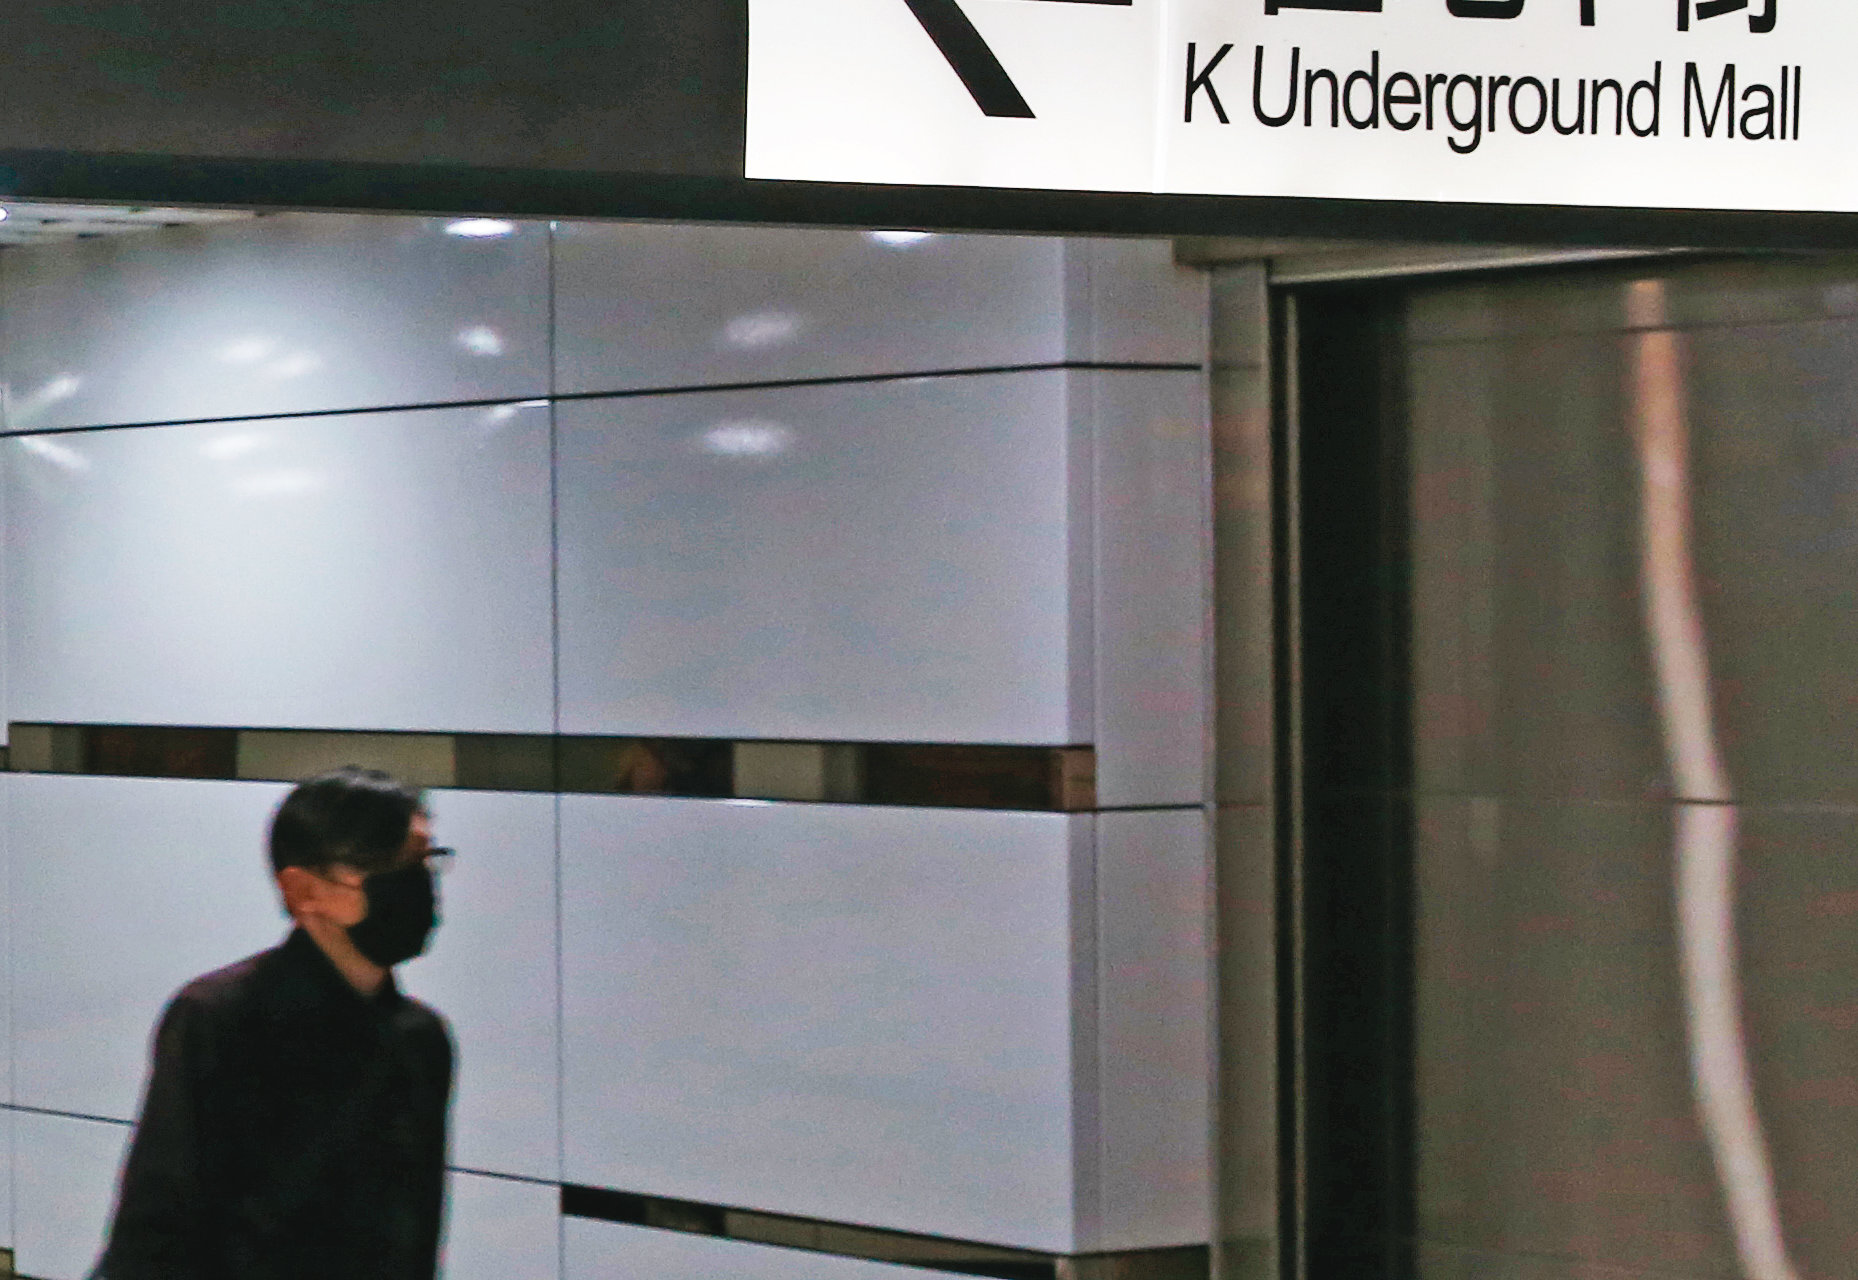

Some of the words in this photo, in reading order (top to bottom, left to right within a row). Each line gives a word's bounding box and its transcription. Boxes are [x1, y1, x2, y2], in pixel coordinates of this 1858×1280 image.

[1184, 42, 1234, 125] K
[1252, 44, 1662, 155] Underground
[1683, 61, 1801, 141] Mall
